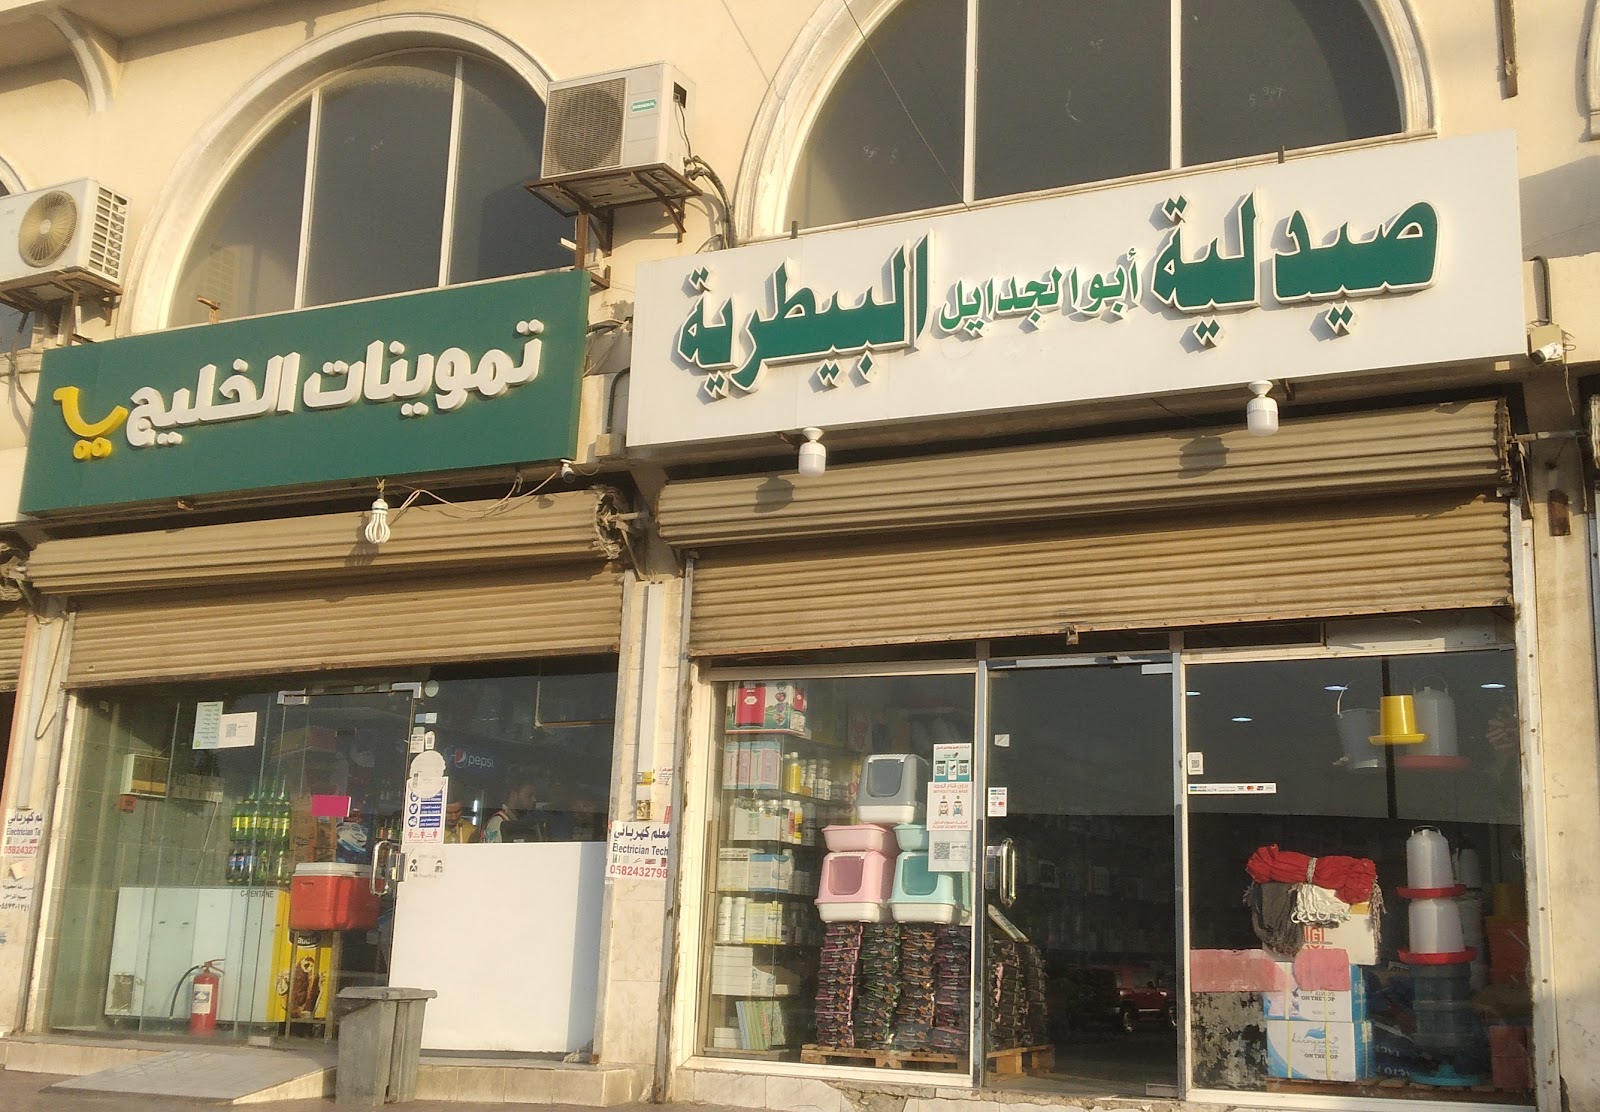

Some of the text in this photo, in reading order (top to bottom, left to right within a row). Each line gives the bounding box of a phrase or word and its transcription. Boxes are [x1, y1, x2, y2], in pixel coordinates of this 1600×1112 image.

[1153, 190, 1440, 347] صيدلية
[677, 232, 934, 397] البيطرية
[126, 318, 545, 447] تموينات الخليج
[467, 754, 494, 769] pepsi
[6, 828, 34, 836] Electrician
[613, 824, 670, 841] معلم كهربائي
[4, 846, 38, 855] 05824327
[612, 842, 650, 855] Electrician
[610, 864, 669, 879] 0582432798
